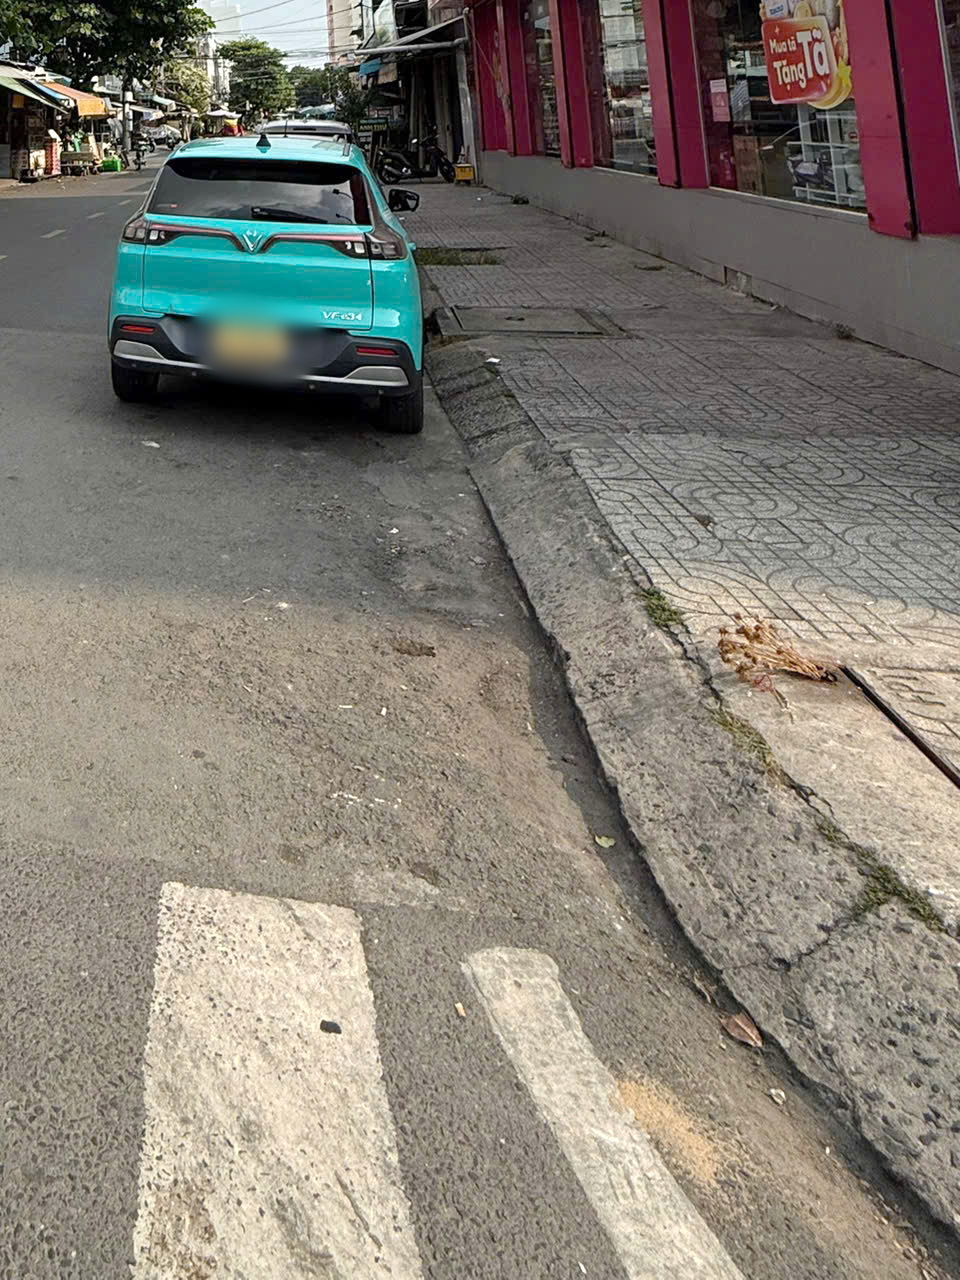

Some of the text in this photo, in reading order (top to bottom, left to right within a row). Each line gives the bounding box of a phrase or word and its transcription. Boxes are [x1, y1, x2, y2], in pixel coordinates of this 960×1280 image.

[769, 39, 787, 54] Mua
[796, 27, 830, 78] Tã
[773, 60, 807, 90] Tặng
